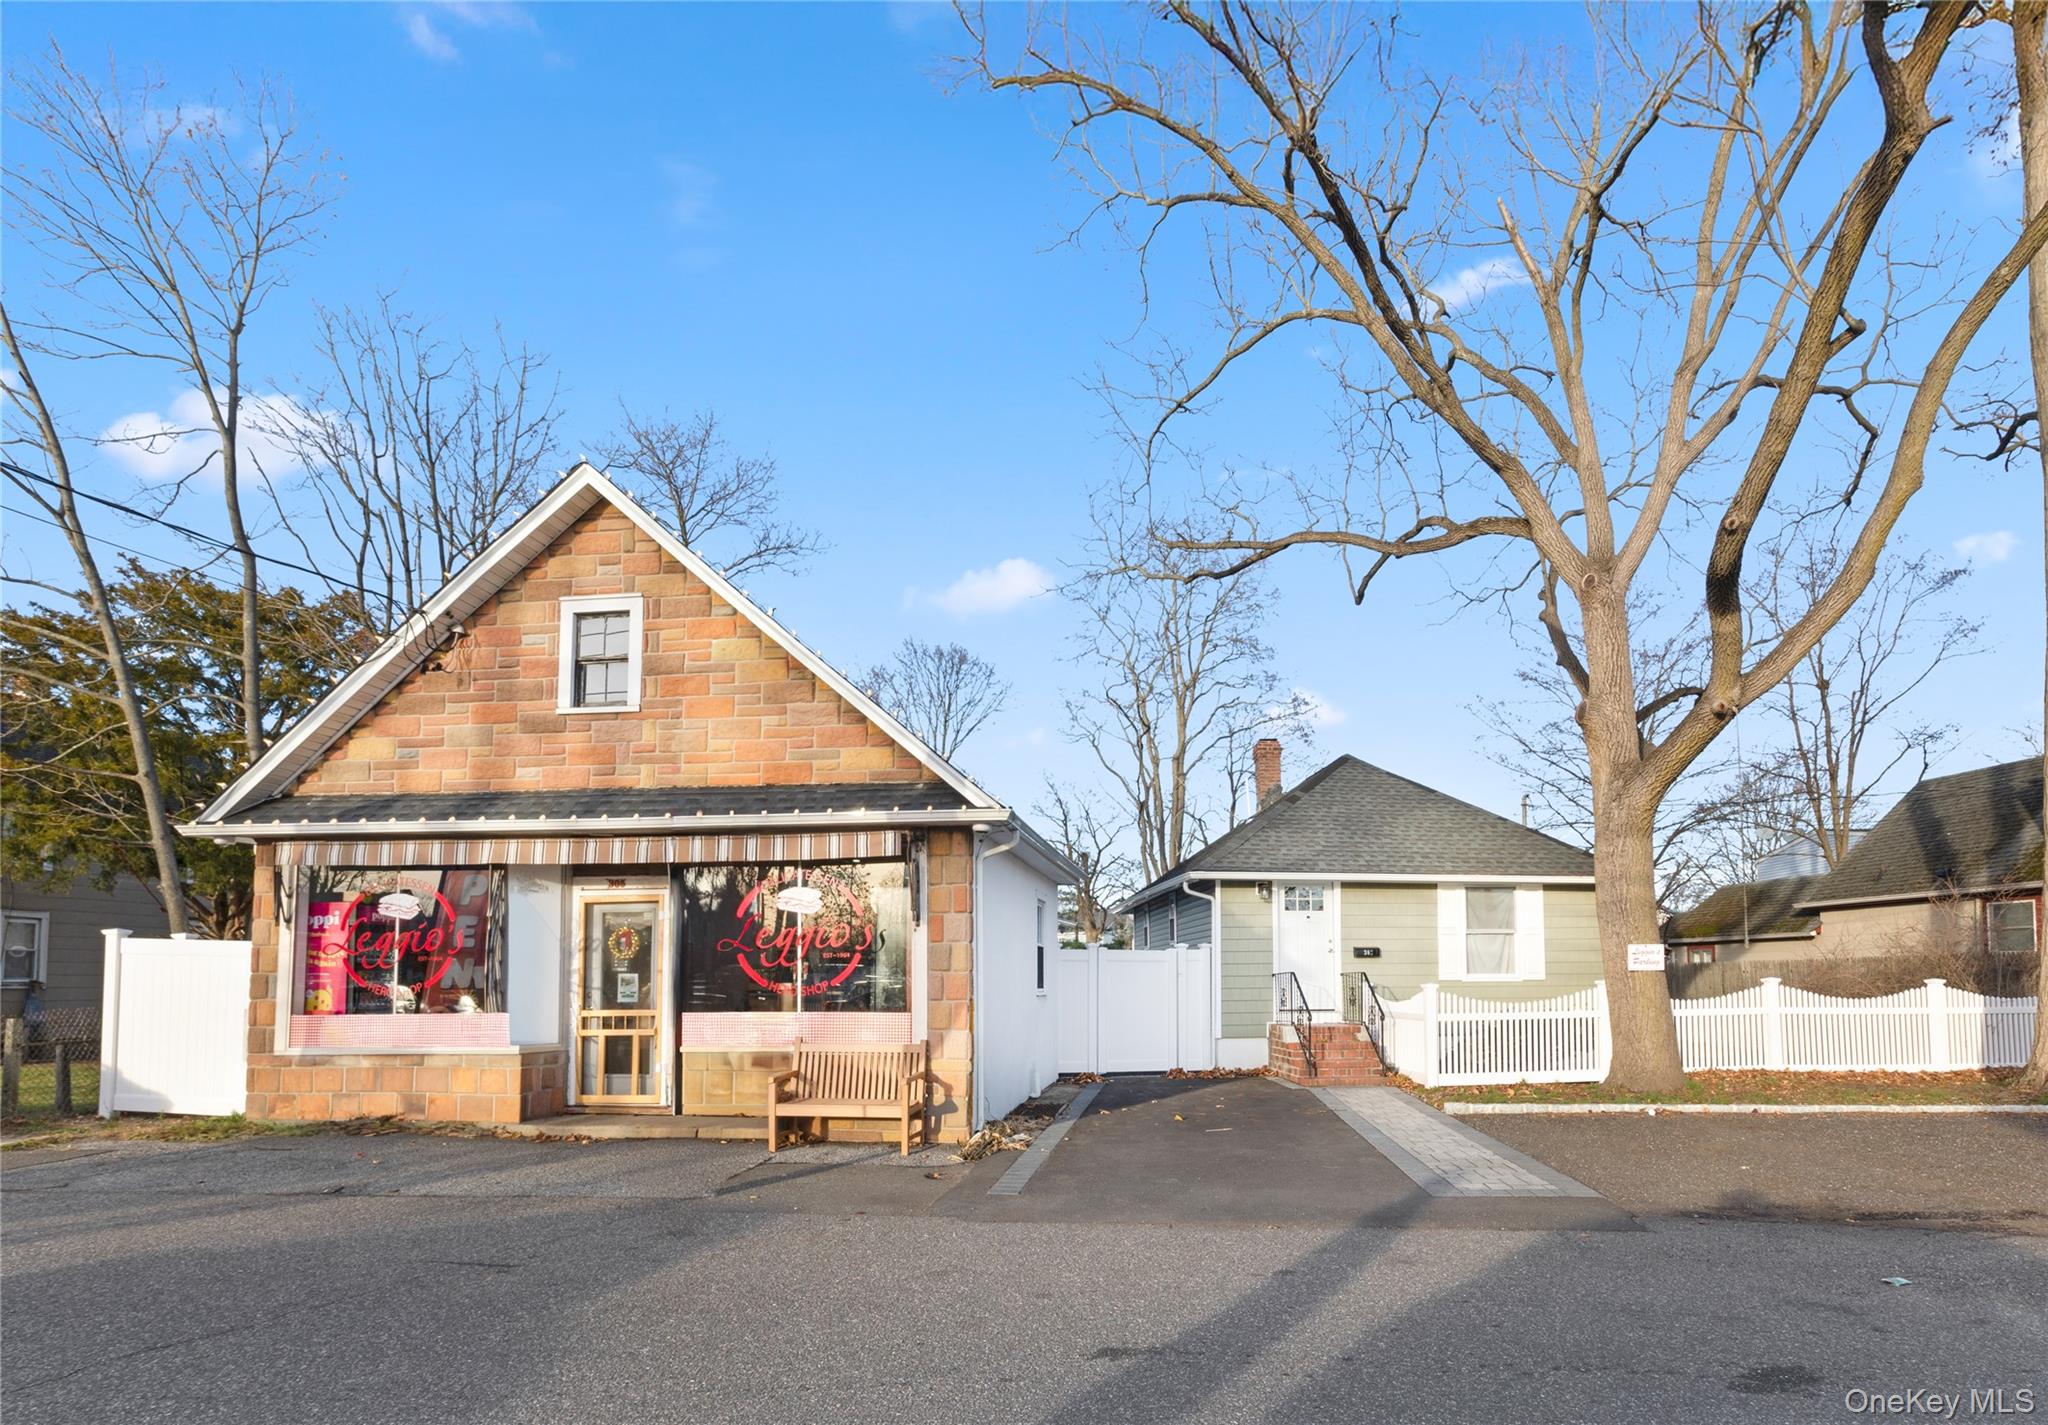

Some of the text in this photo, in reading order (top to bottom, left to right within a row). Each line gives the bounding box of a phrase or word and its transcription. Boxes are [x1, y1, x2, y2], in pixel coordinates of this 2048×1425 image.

[322, 916, 464, 970] Leggio's
[717, 912, 874, 968] Leggio's
[800, 980, 829, 996] SHOP
